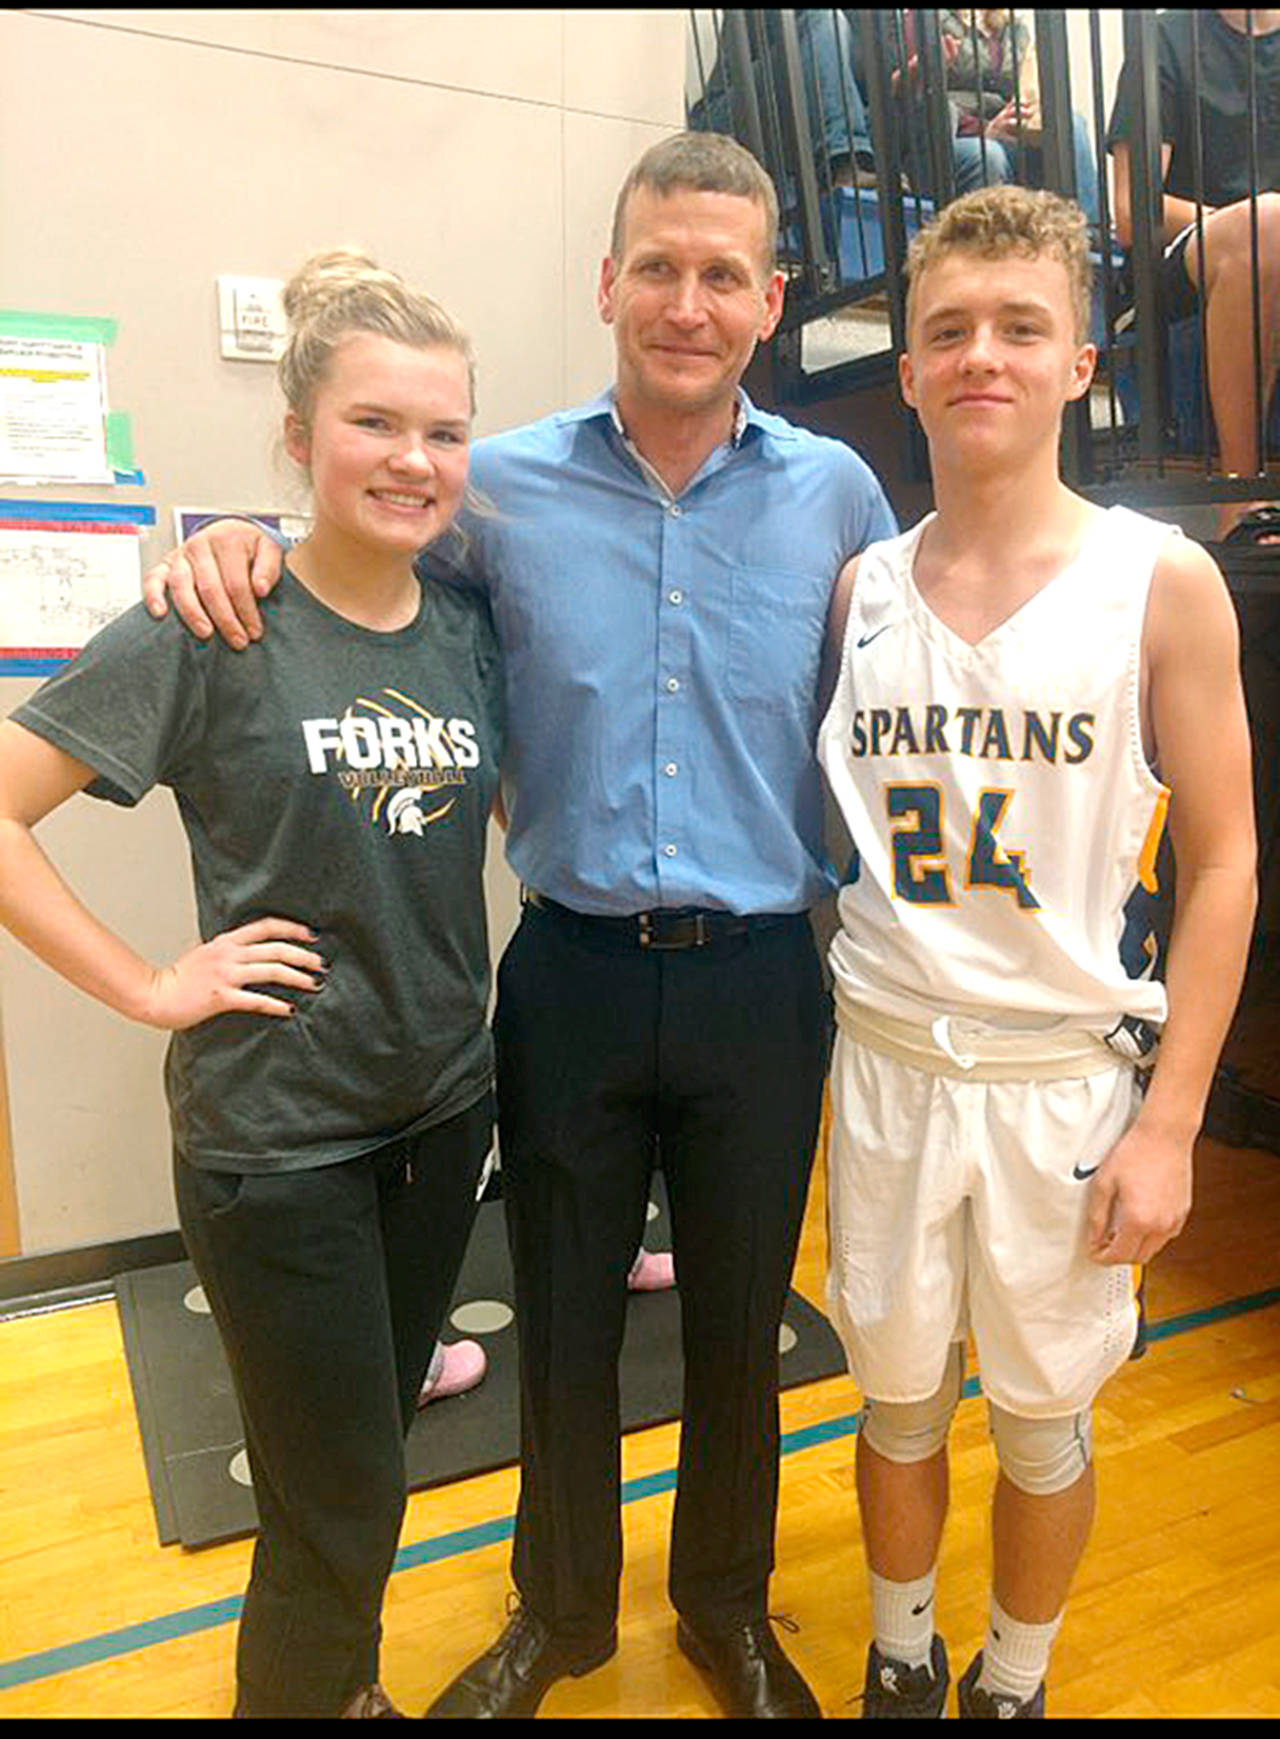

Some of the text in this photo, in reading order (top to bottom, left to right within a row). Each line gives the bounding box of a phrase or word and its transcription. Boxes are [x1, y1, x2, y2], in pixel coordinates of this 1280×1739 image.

[241, 315, 269, 328] FIRE
[302, 717, 480, 775] FORKS
[851, 704, 1095, 765] SPARTANS
[884, 780, 1044, 913] 24
